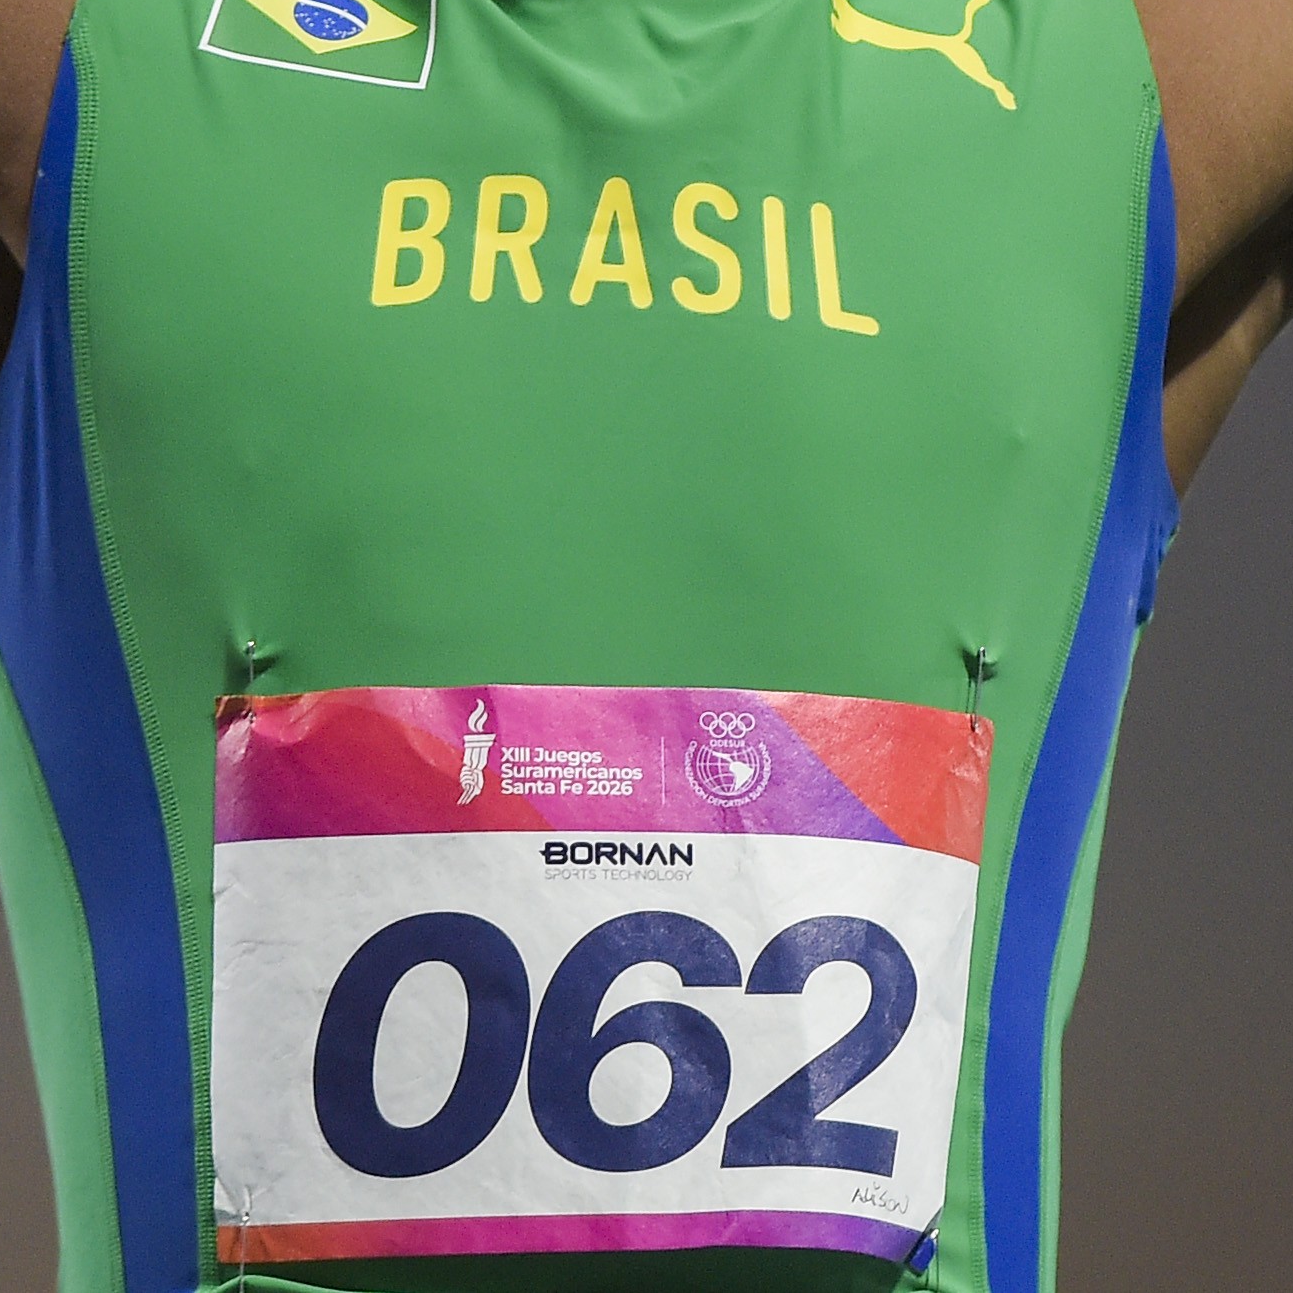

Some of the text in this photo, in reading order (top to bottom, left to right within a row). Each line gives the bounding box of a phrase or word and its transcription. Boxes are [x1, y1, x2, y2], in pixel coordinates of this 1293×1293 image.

[370, 174, 881, 337] BRASIL
[501, 747, 603, 766] XIII Juegos
[501, 763, 643, 780] Suramericanos
[501, 779, 633, 795] Santa Fe 2026
[539, 841, 694, 866] BORNAN
[544, 868, 694, 882] SPORTS TECHNOLOGY
[313, 910, 918, 1179] 062
